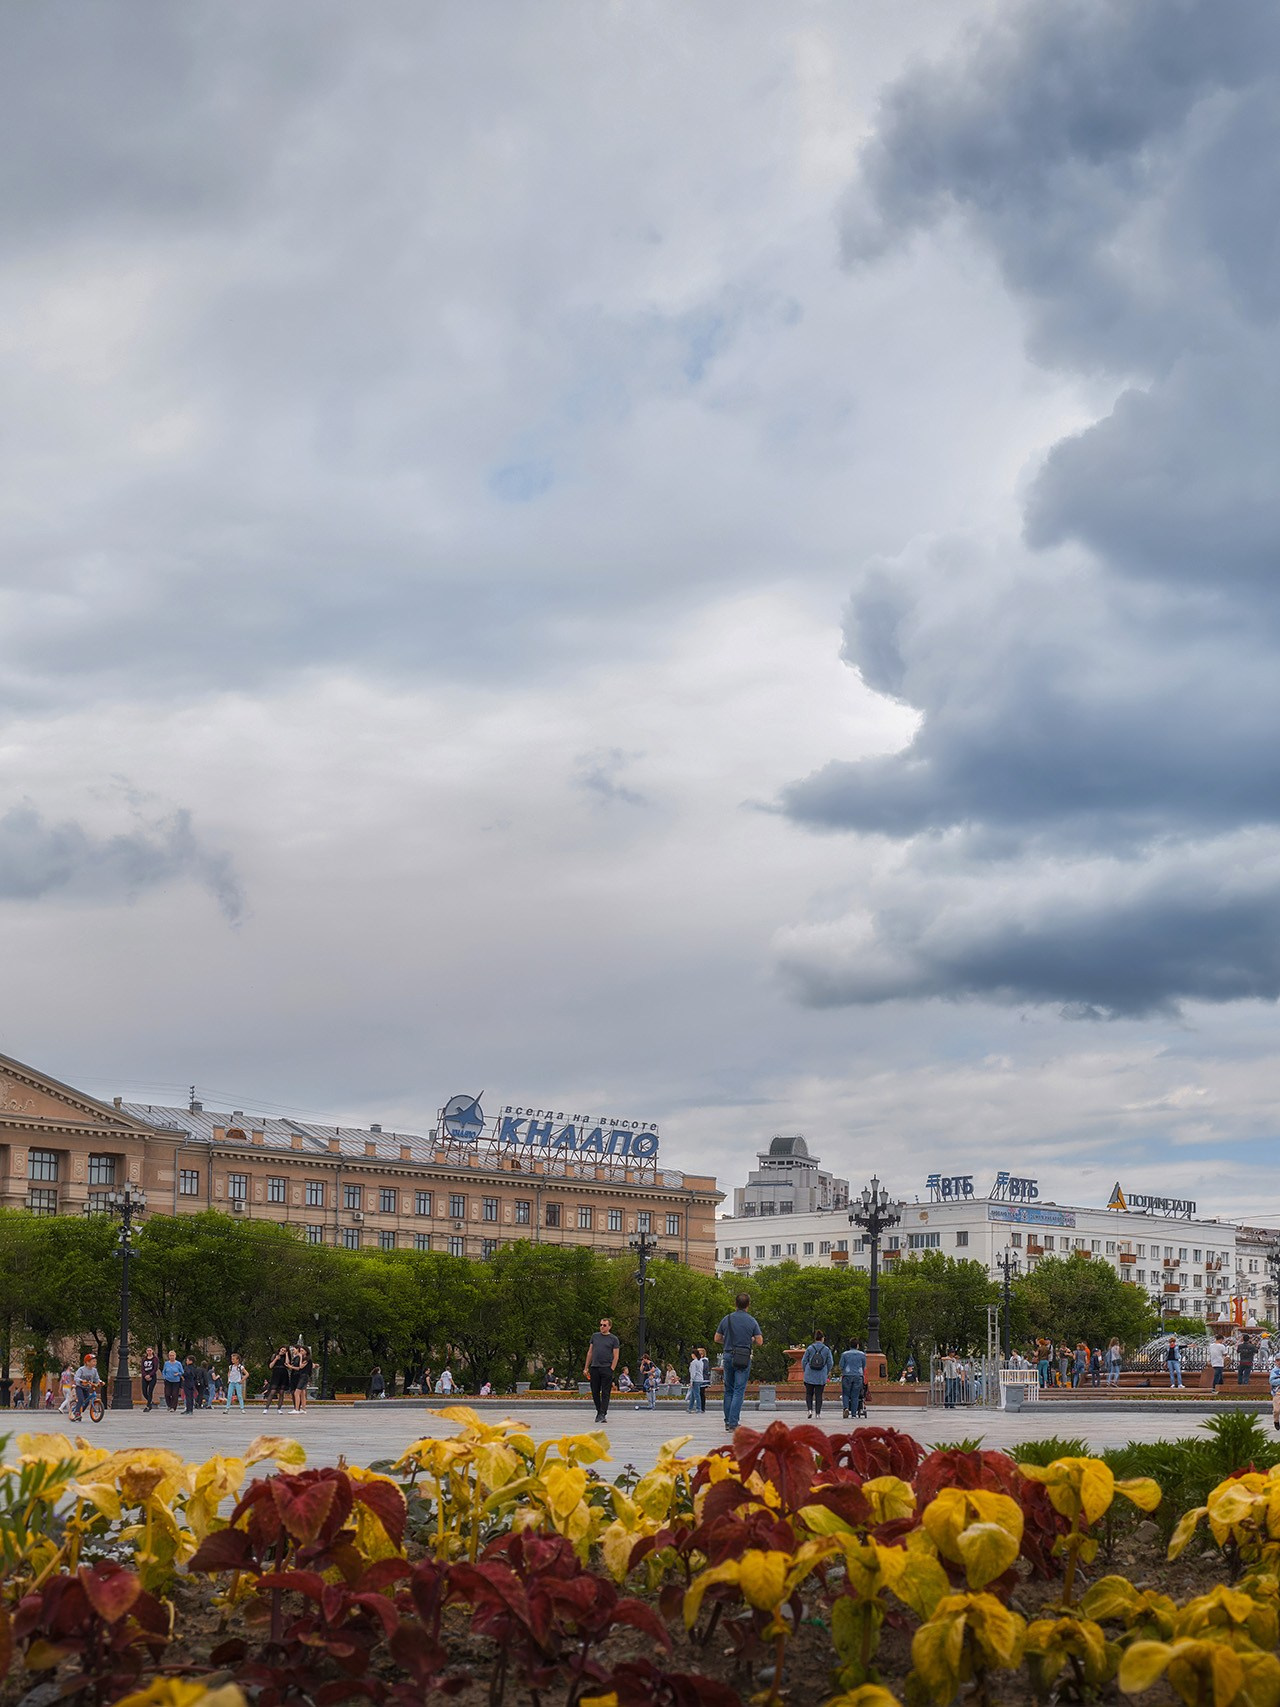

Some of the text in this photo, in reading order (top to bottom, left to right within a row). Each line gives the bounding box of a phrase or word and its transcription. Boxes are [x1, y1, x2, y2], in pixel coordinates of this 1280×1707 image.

[505, 1106, 657, 1131] всегда на высоте
[500, 1116, 659, 1158] КНААПО
[941, 1176, 974, 1196] ВТБ
[1009, 1177, 1039, 1198] ВТБ
